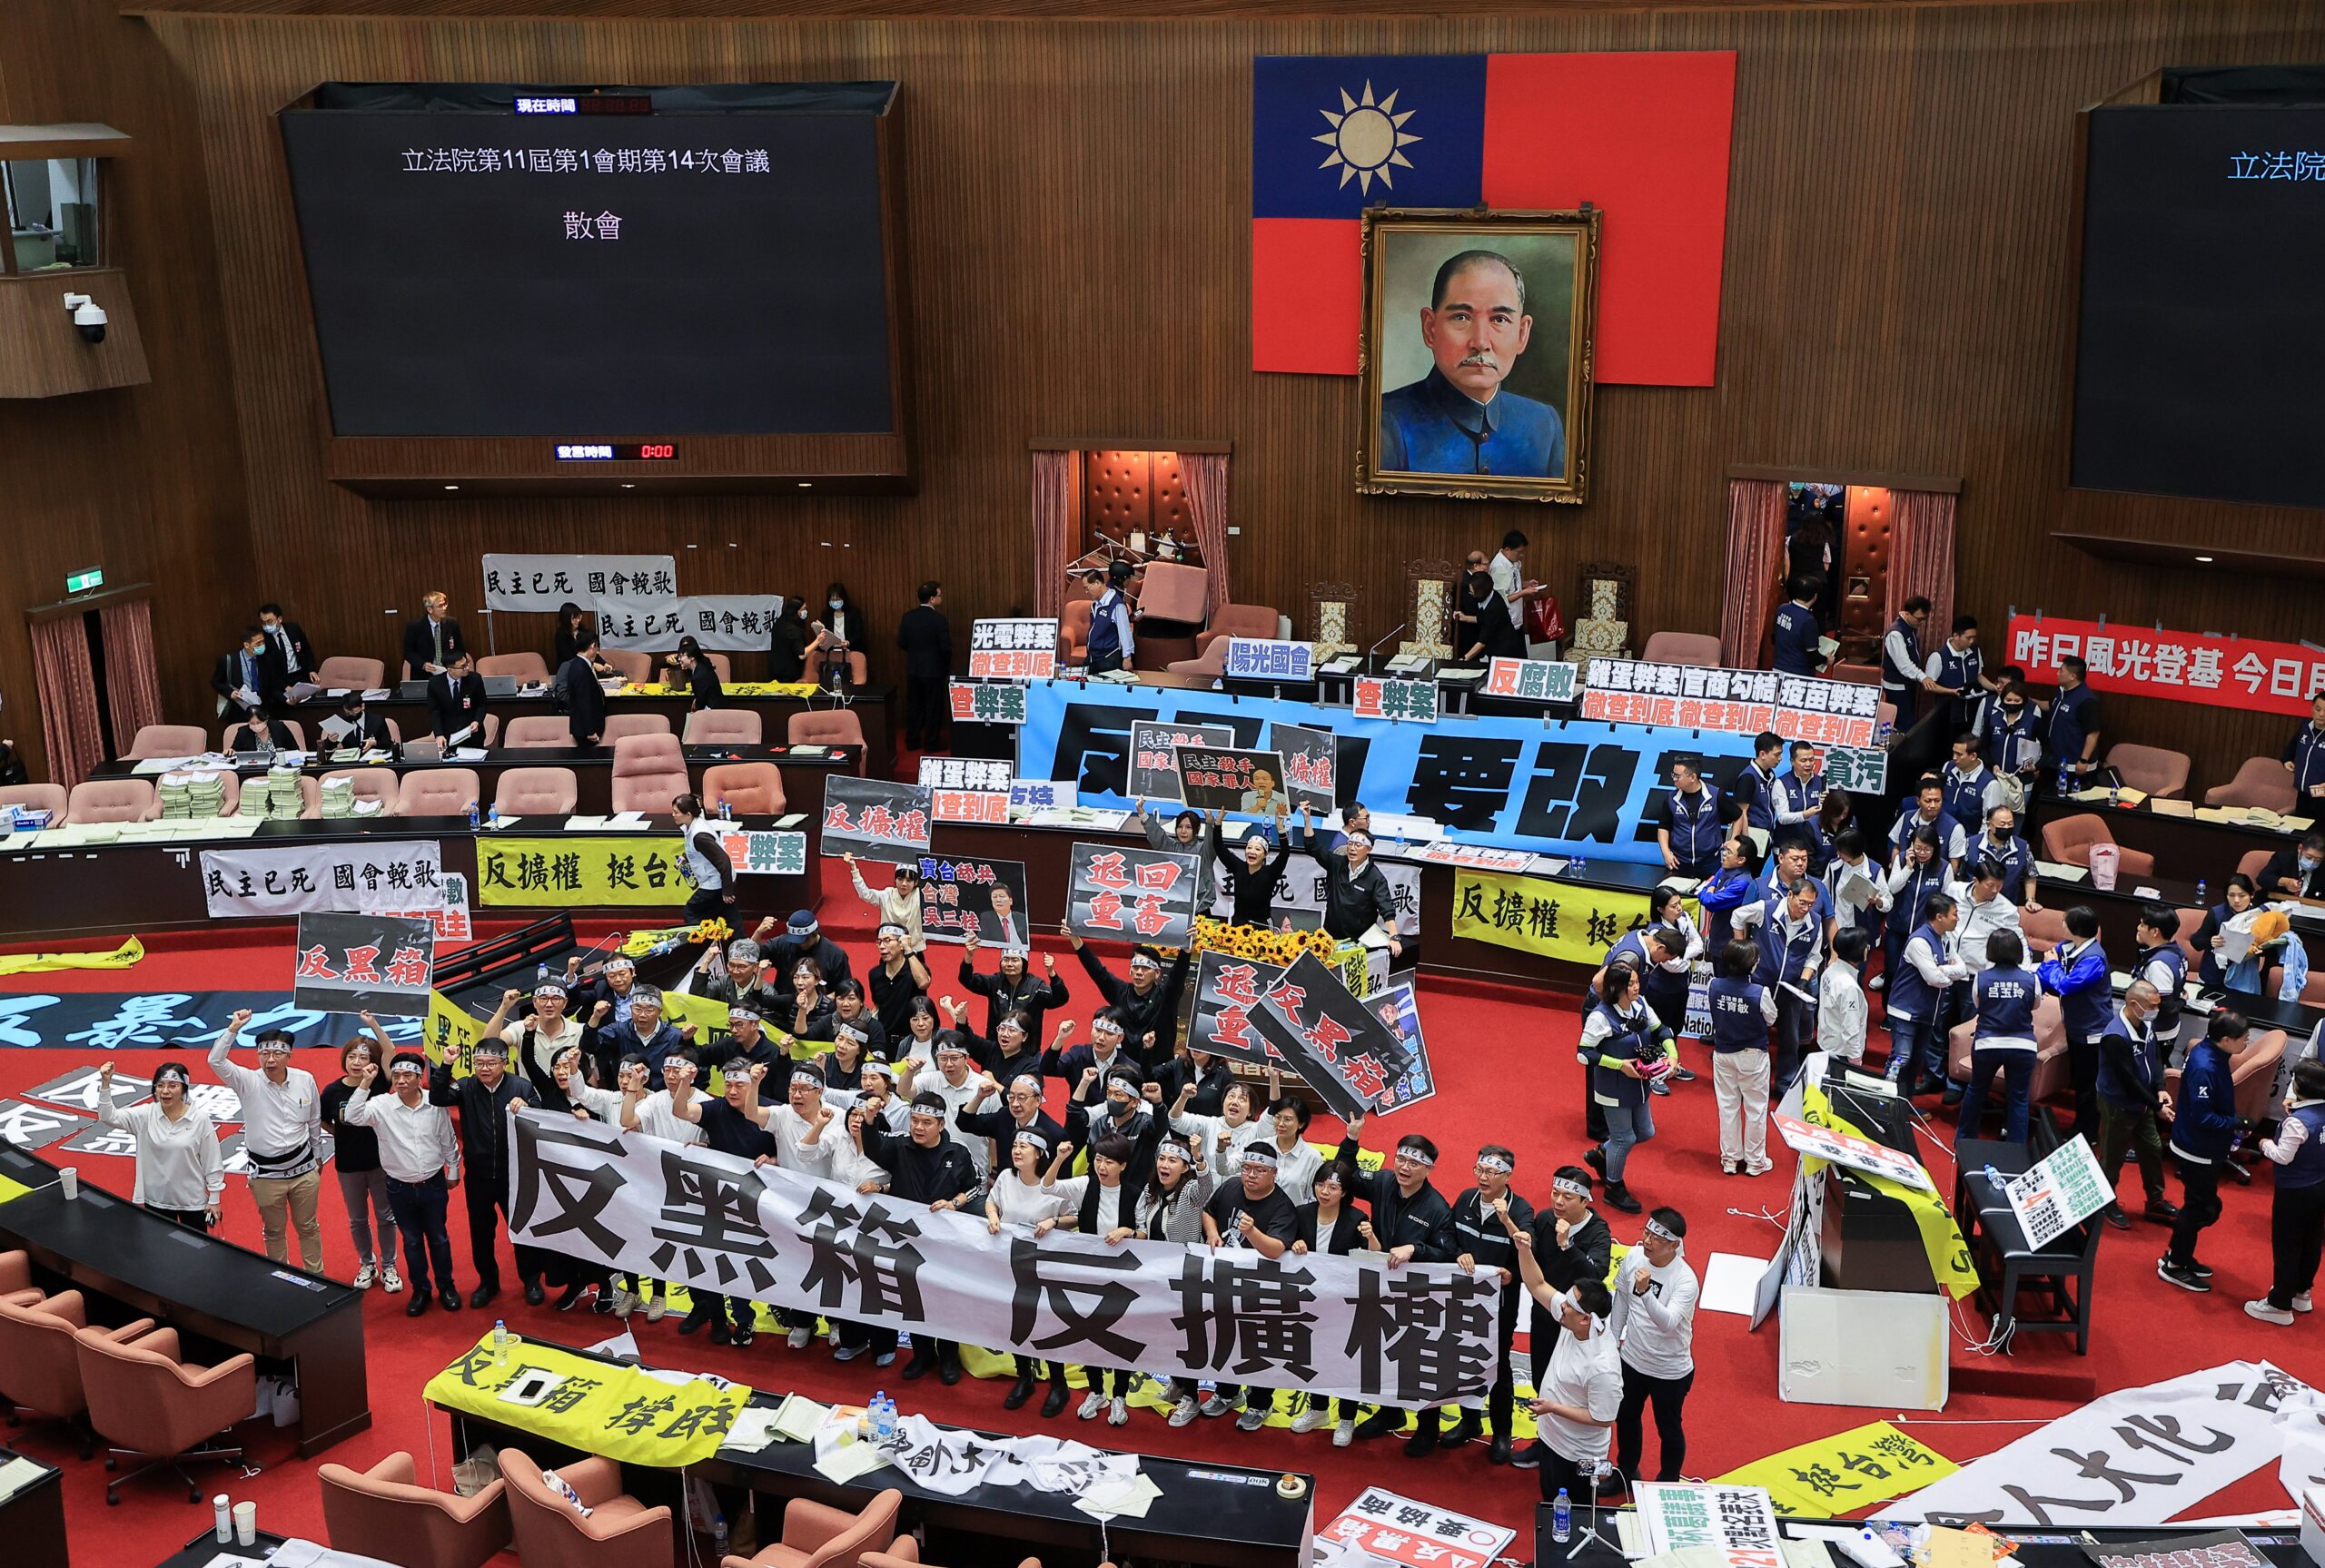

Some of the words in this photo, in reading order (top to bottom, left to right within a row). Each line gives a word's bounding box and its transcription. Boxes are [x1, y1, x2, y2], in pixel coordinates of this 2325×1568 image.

[517, 98, 576, 113] 現在時間
[401, 148, 770, 173] 立法院第11屆第1會期第14次會議
[2228, 151, 2325, 181] 立法院
[563, 210, 622, 240] 散會
[641, 445, 673, 458] 0:00
[487, 570, 573, 596] 民主已死
[588, 571, 674, 596] 國會輓歌
[601, 612, 685, 638] 民主已死
[973, 624, 1056, 650] 光電弊案
[971, 650, 1054, 677] 徹查到底
[1232, 642, 1311, 676] 陽光國會
[2014, 628, 2224, 689] 昨日風光登基
[1489, 661, 1575, 698] 反腐敗
[1588, 659, 1681, 695] 雞蛋弊案
[1684, 667, 1776, 704] 官商勾結
[951, 684, 1024, 720] 查弊案
[1356, 681, 1436, 719] 查弊案
[1584, 691, 1675, 726] 徹查到底
[1780, 678, 1879, 717] 疫苗弊案
[1678, 698, 1773, 734] 徹查到底
[1775, 709, 1872, 748] 徹查到底
[919, 759, 1011, 790] 雞蛋弊案
[1182, 753, 1254, 774] 民主殺手
[1187, 771, 1259, 791] 國家罪人
[1282, 750, 1333, 790] 擴權
[1815, 750, 1885, 789] 貪污
[826, 804, 928, 843] 反擴權
[723, 834, 806, 871] 查弊案
[208, 867, 316, 898] 民主已死
[333, 860, 440, 892] 國會輓歌
[484, 852, 583, 890] 反擴權
[920, 857, 996, 886] 賣台舔共
[1087, 851, 1182, 892] 退回
[442, 877, 465, 904] 數
[922, 883, 958, 907] 台灣
[924, 907, 980, 933] 吳三桂
[1084, 893, 1173, 936] 重審
[1458, 883, 1559, 939] 反擴權
[297, 943, 431, 987] 反黑箱
[1213, 963, 1265, 1005] 退
[1988, 987, 2025, 999] 呂玉玲
[1717, 999, 1749, 1014] 王育敏
[1269, 978, 1389, 1100] 反黑箱
[508, 1116, 926, 1322] 反黑箱
[1010, 1237, 1498, 1402] 反擴權
[1358, 1494, 1471, 1538] 要協商
[1715, 1492, 1779, 1568] 21次點名表決
[1331, 1517, 1455, 1562] 反黑箱
